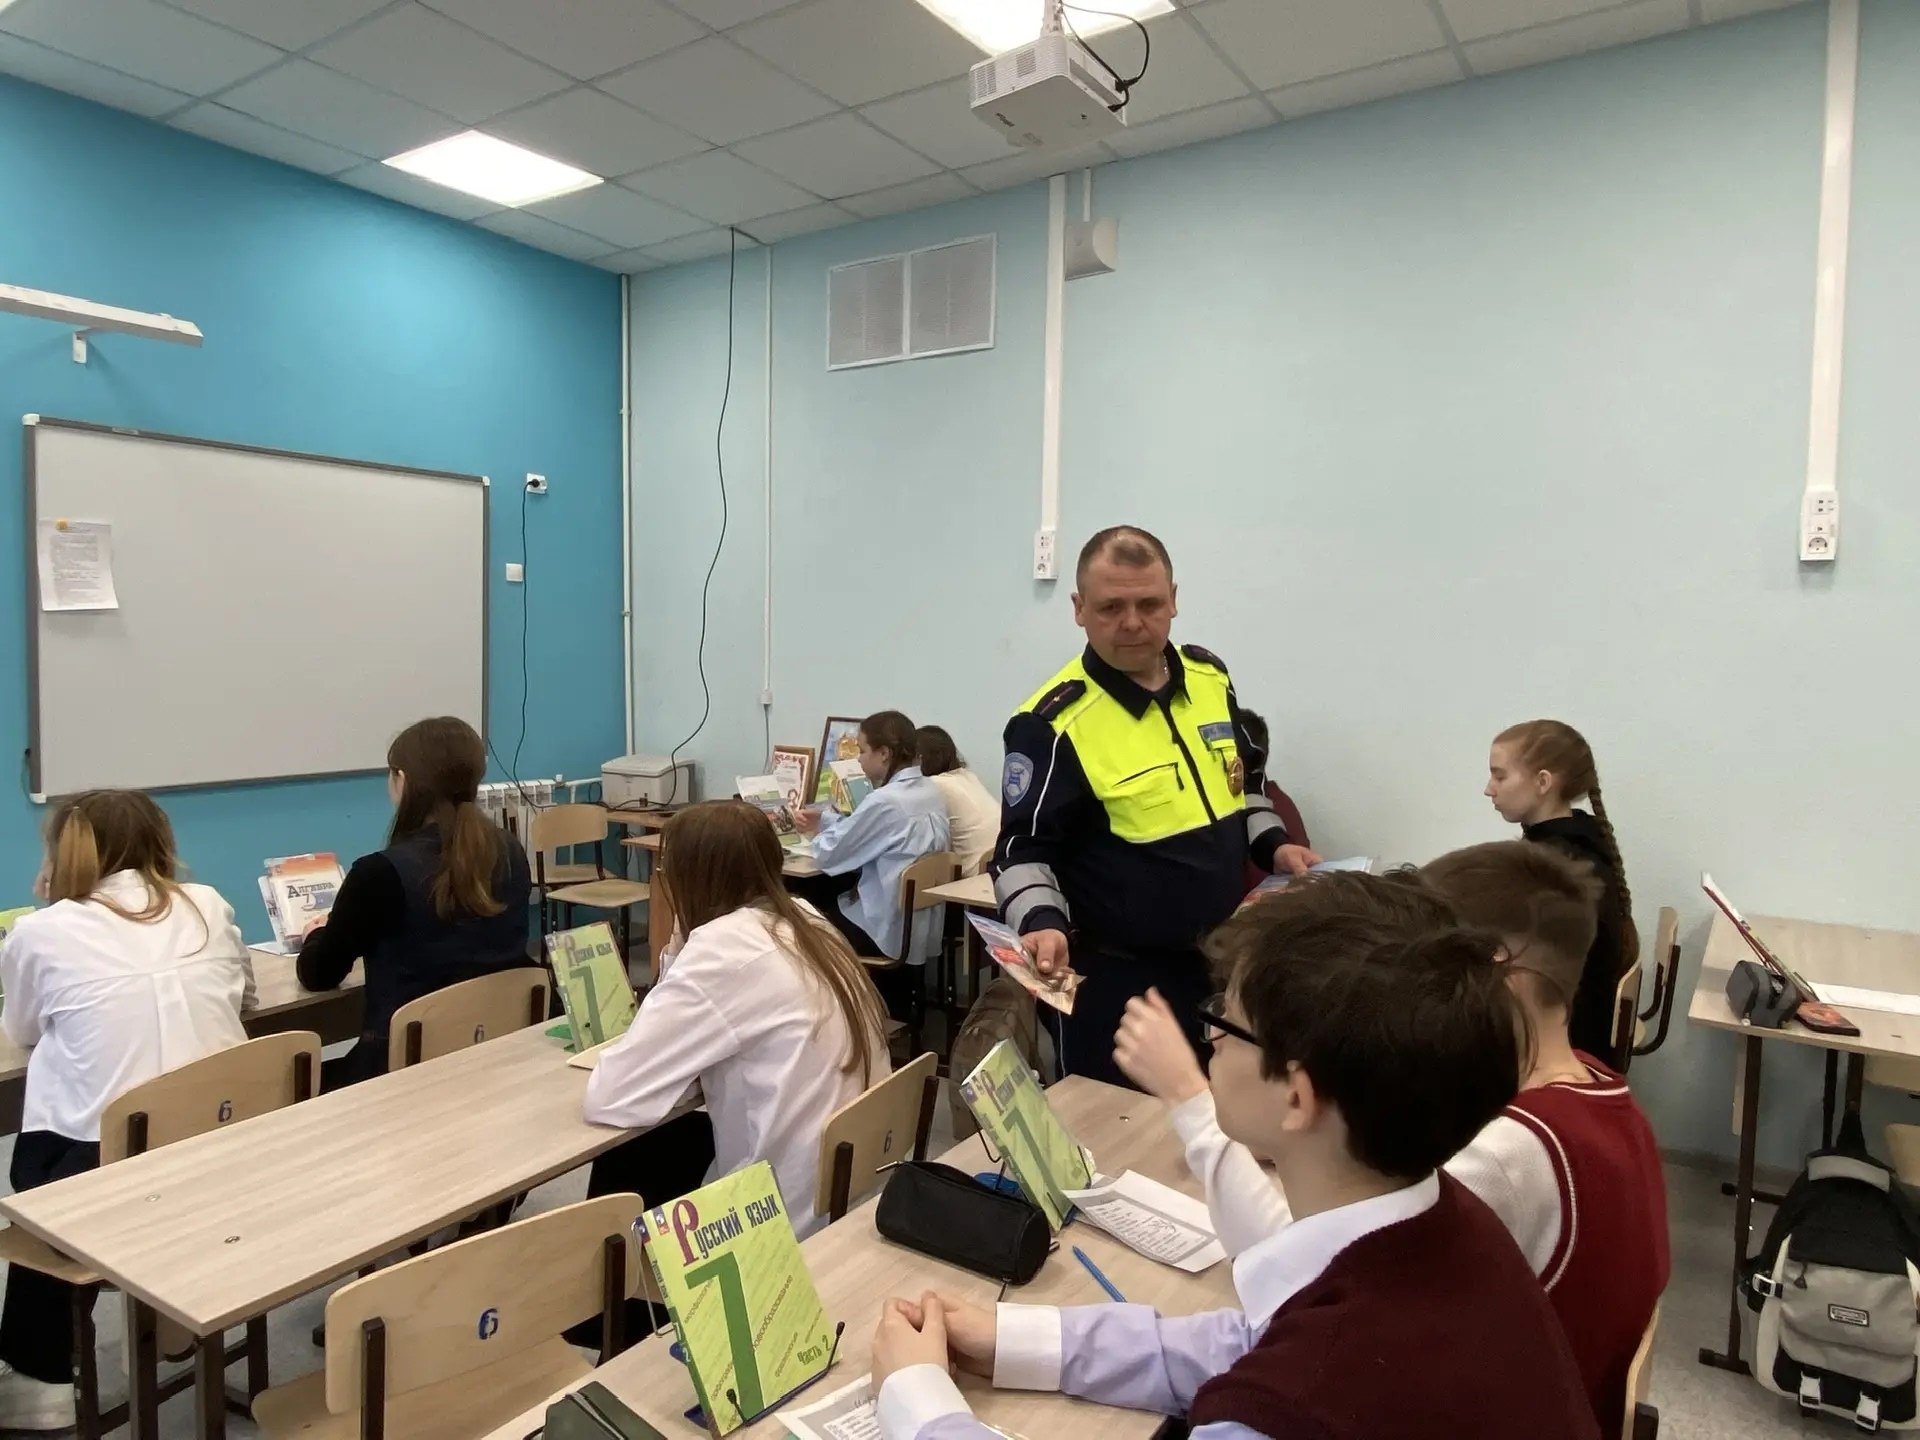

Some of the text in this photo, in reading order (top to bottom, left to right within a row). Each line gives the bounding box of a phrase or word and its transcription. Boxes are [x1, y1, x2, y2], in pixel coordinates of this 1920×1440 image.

[569, 964, 605, 1045] 7
[218, 1100, 232, 1122] 6
[884, 1129, 892, 1154] 6
[1003, 1106, 1073, 1220] 7
[672, 1193, 781, 1267] Русский язык
[479, 1308, 499, 1340] 6
[684, 1251, 764, 1421] 7
[797, 1334, 831, 1366] Часть 2
